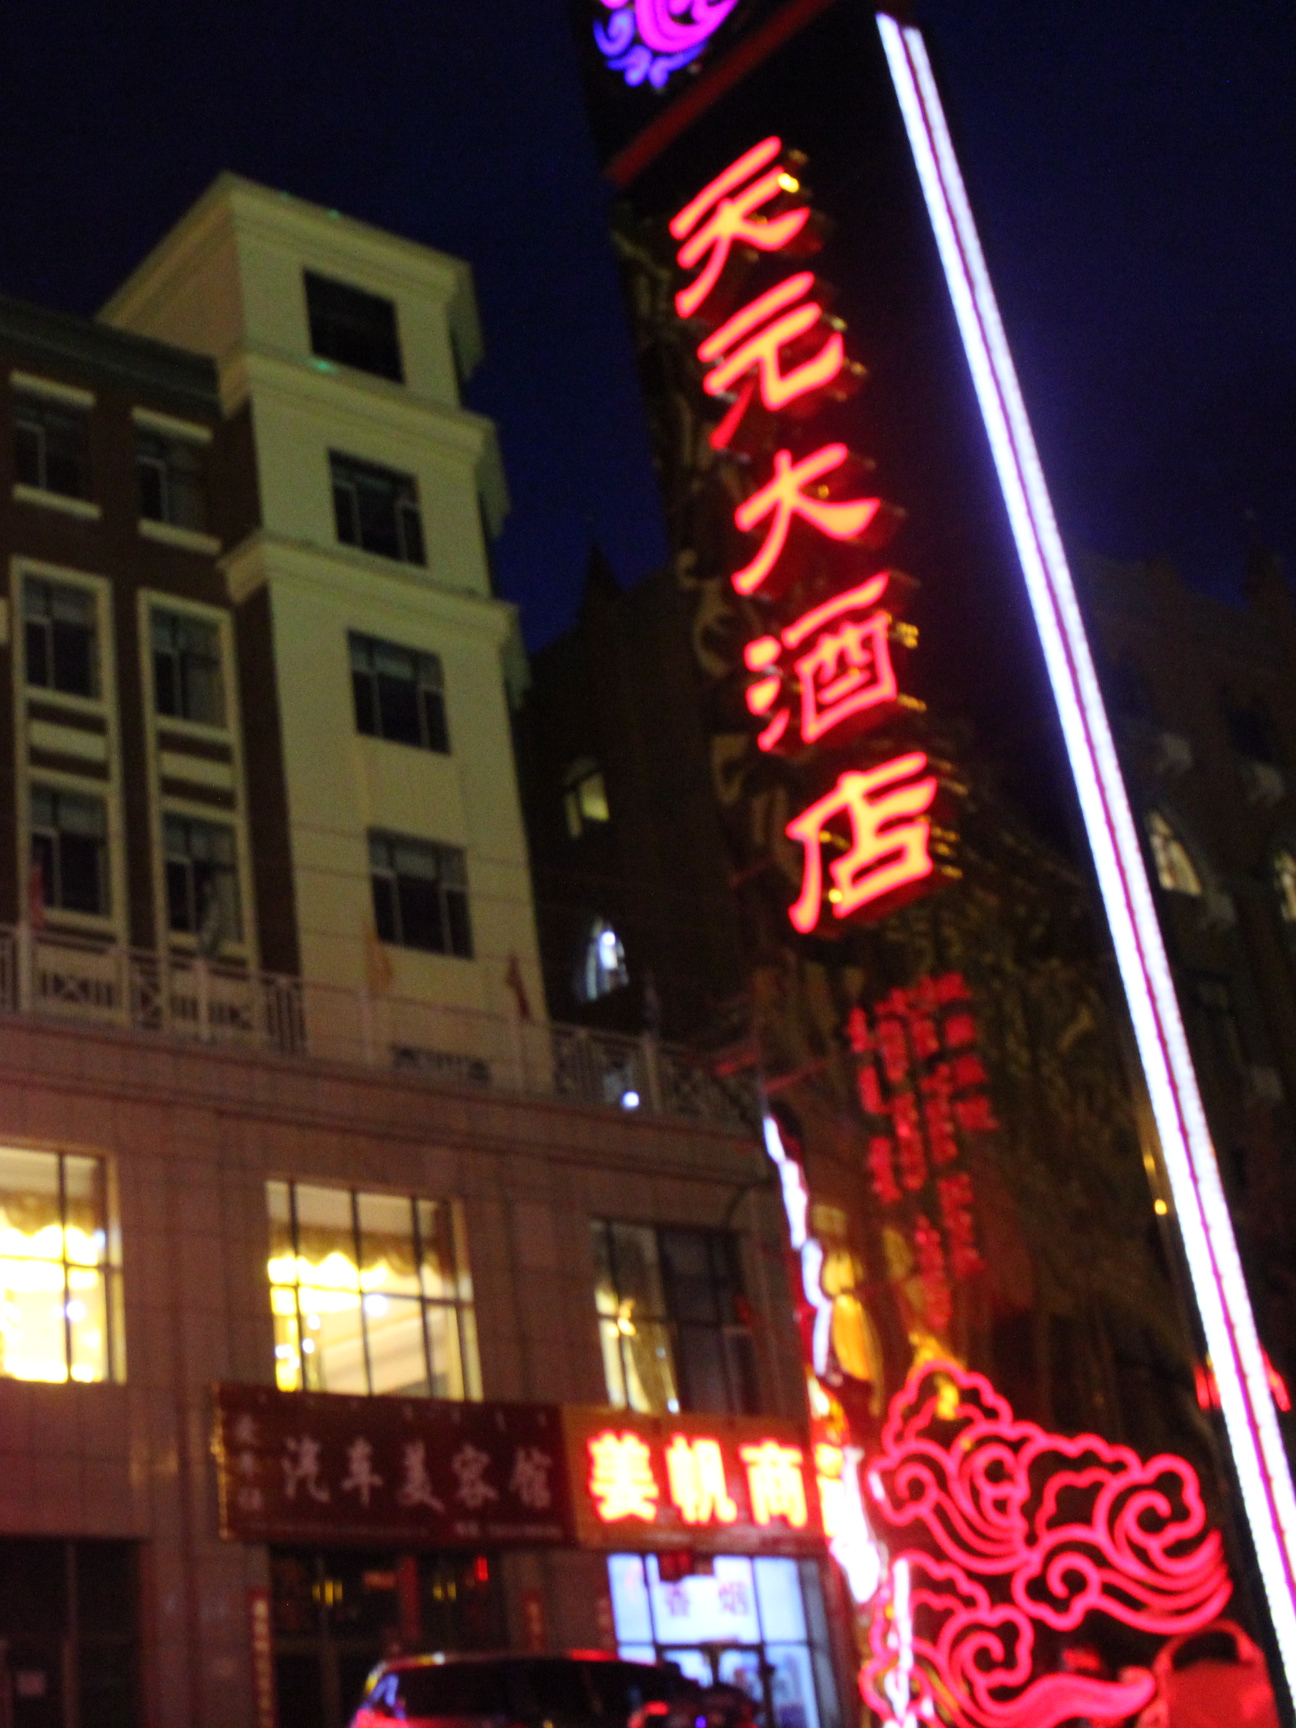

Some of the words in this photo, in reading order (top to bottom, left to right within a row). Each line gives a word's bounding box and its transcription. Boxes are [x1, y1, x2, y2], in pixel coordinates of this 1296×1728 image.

[668, 134, 938, 934] 天元大酒店
